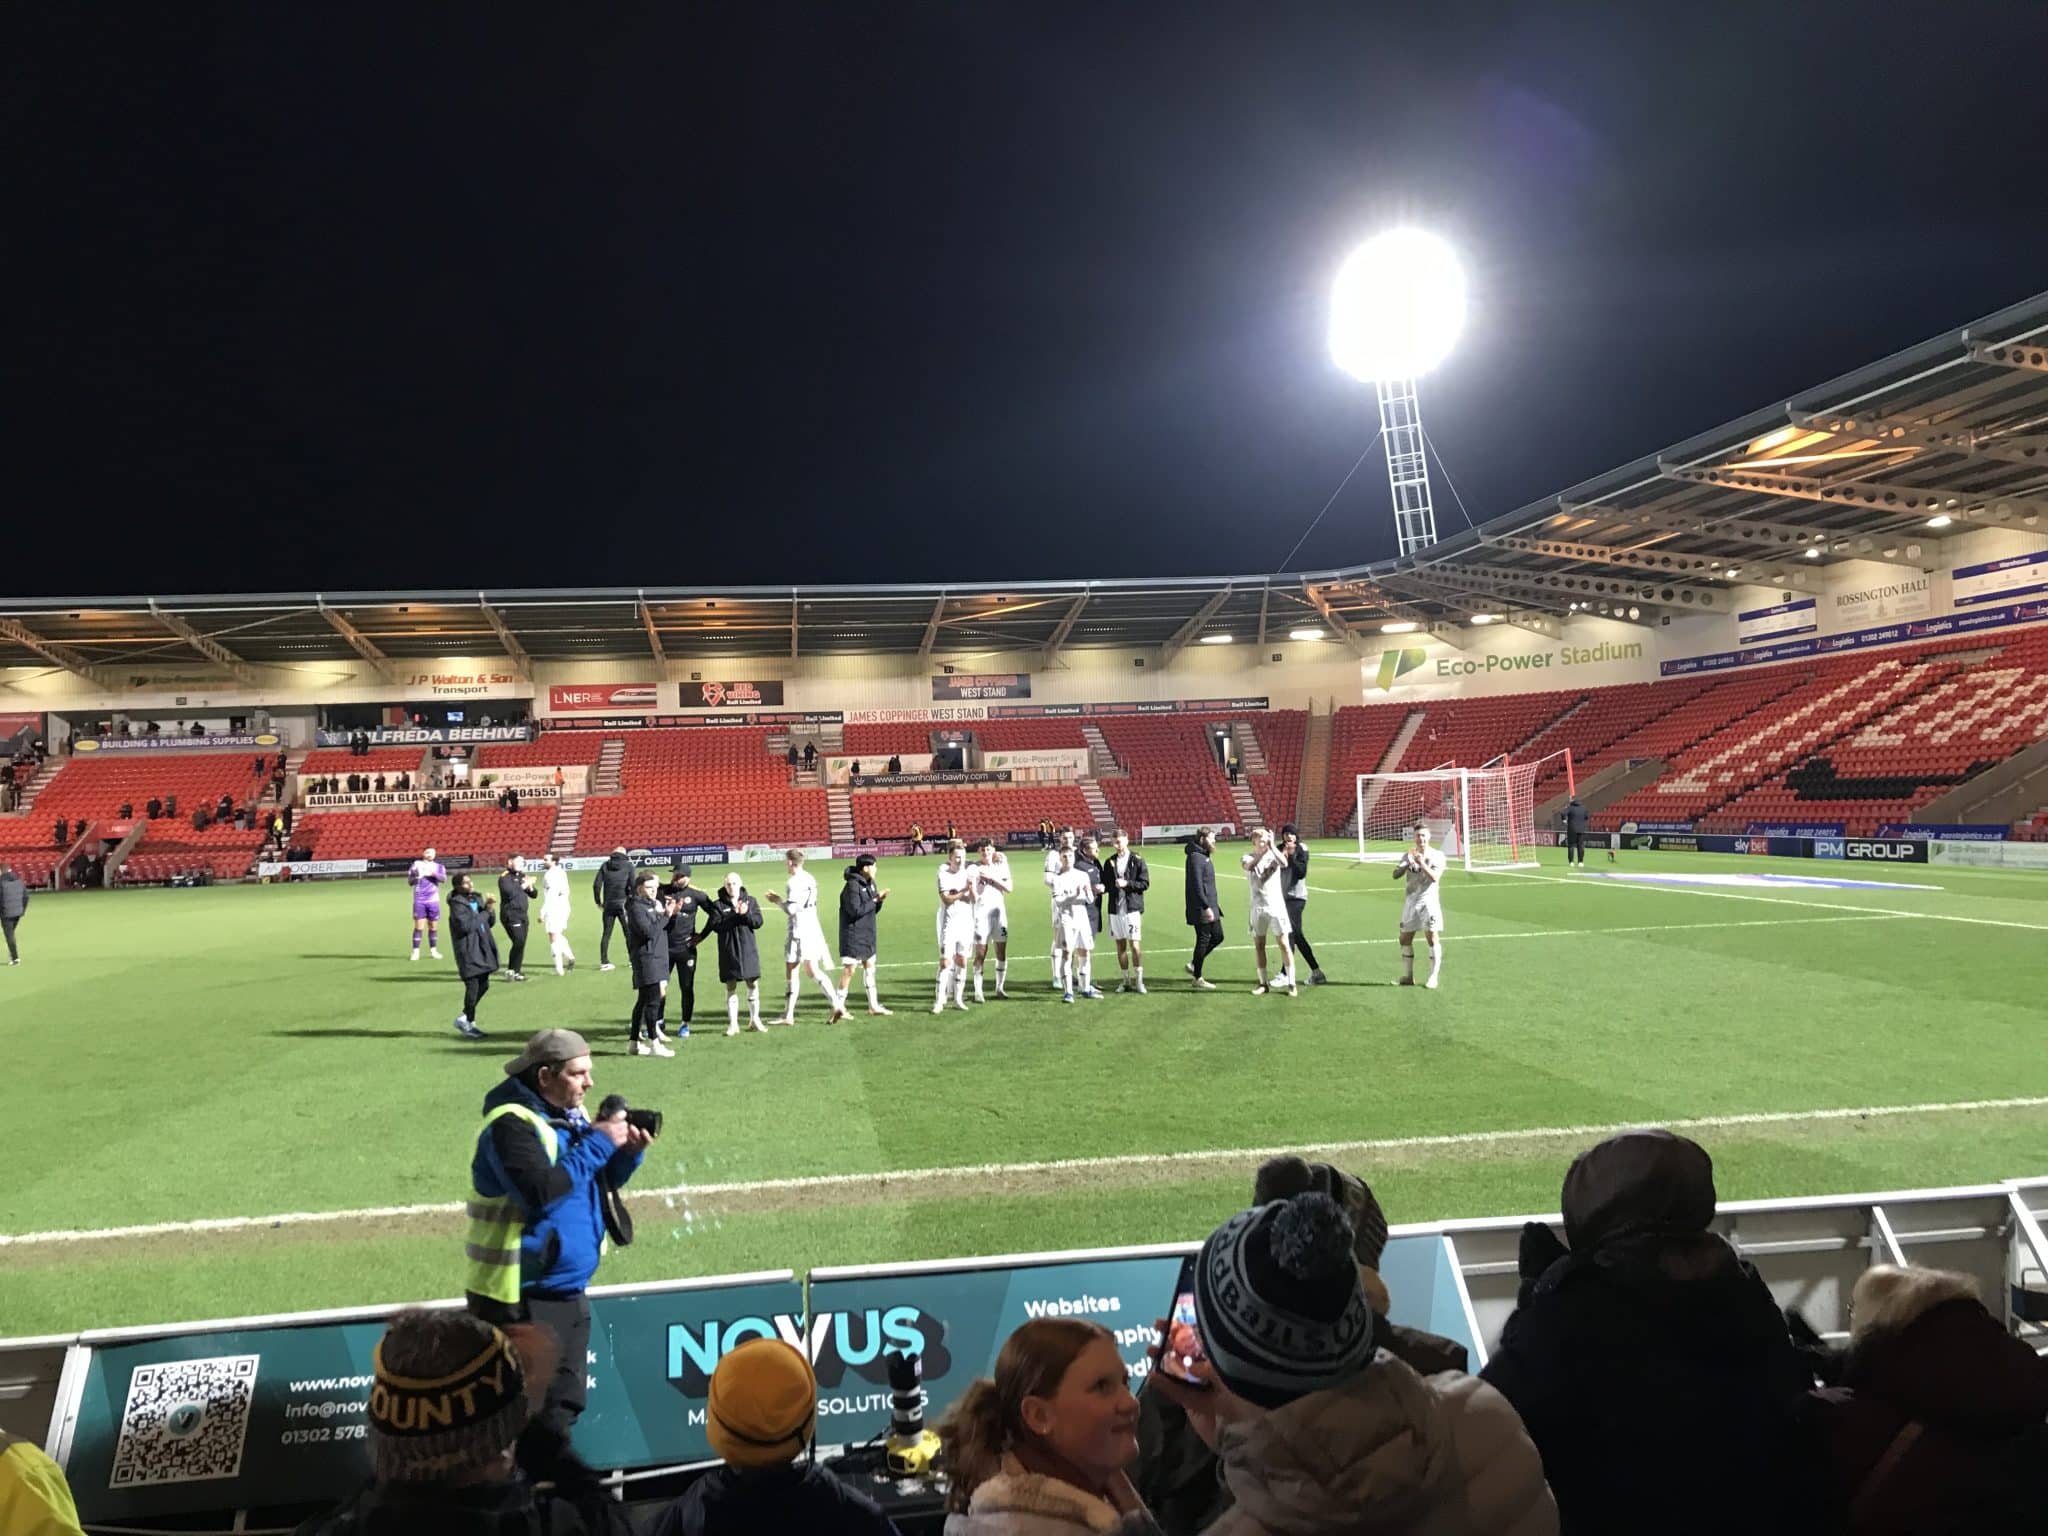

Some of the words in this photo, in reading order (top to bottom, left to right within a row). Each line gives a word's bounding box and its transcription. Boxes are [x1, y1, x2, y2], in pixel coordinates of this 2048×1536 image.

[1836, 583, 1899, 606] ROSSINGTON
[1901, 579, 1928, 594] HALL
[1437, 652, 1553, 676] Eco-Power
[1560, 641, 1642, 666] Stadium
[432, 674, 473, 685] Walton
[432, 685, 488, 695] Transport
[961, 688, 981, 697] WEST
[983, 687, 1006, 697] STAND
[554, 693, 591, 704] LNER
[850, 711, 877, 721] JAMES
[880, 710, 928, 721] COPPINGER
[931, 709, 953, 719] WEST
[957, 708, 984, 718] STAND
[448, 727, 526, 741] BEEHIVE
[102, 739, 148, 749] BUILDING
[151, 739, 158, 748] &
[160, 738, 210, 747] PLUMBING
[212, 736, 254, 746] SUPPLIES
[874, 772, 989, 785] www.crownhotel-bawtry.com
[309, 796, 351, 805] ADRIAN
[355, 794, 394, 804] WELCH
[449, 790, 495, 801] GLAZING
[1735, 839, 1749, 852] sky
[1751, 839, 1768, 851] bet
[1847, 844, 1914, 858] GROUP
[645, 856, 671, 865] OXEN
[1023, 1293, 1121, 1318] Websites
[667, 1305, 926, 1380] NOVUS
[281, 1427, 330, 1445] 01302
[334, 1424, 368, 1441] 578
